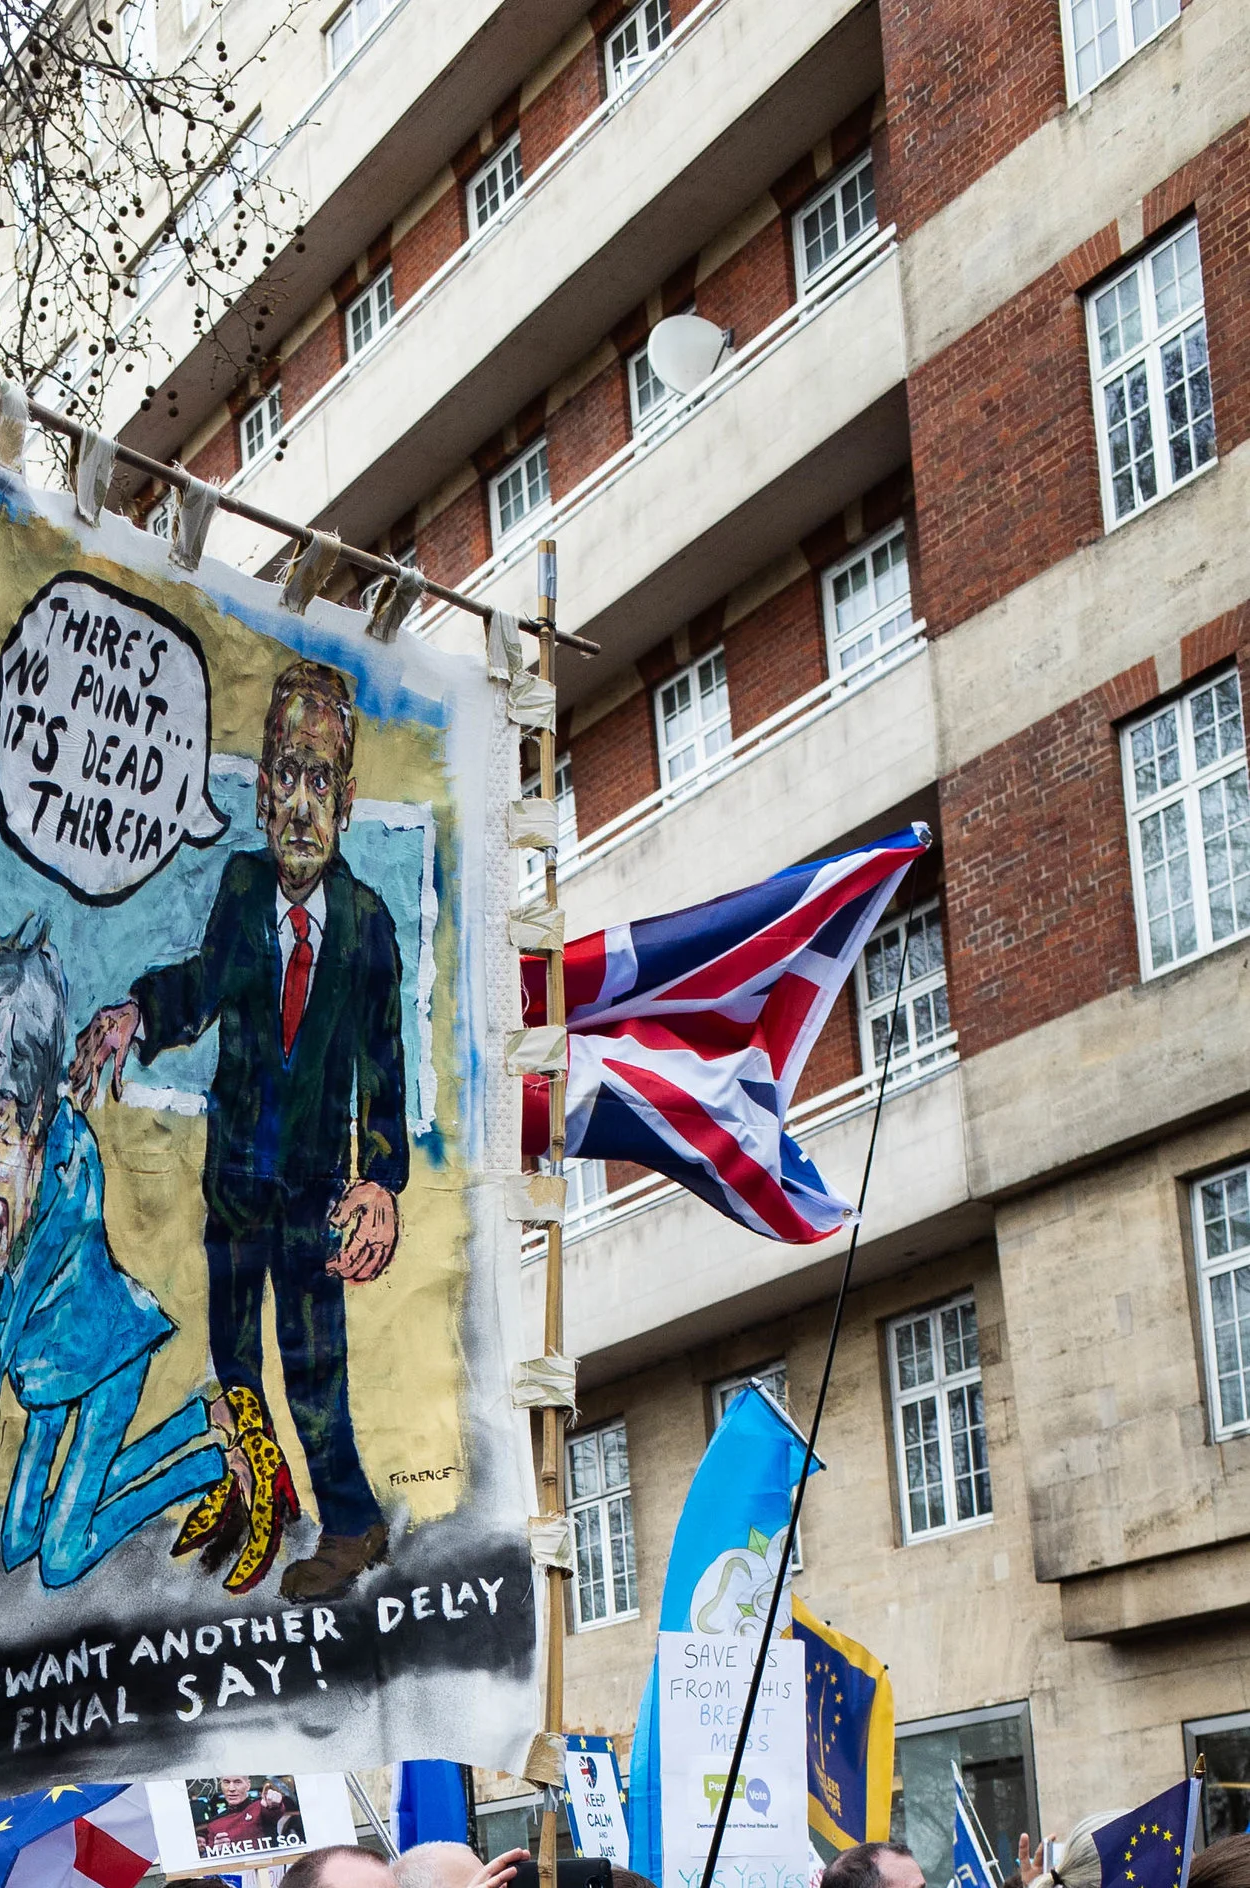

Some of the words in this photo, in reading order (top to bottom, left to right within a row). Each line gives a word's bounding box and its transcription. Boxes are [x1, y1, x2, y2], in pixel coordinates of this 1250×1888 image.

[46, 597, 168, 687] THERE'S
[5, 647, 49, 696] NO
[71, 664, 193, 750] POINT...
[3, 704, 68, 775] IT'S
[81, 729, 164, 795] DEAD
[5, 1638, 116, 1697] WANT
[129, 1606, 344, 1666] ANOTHER
[376, 1576, 504, 1634] DELAY
[684, 1644, 738, 1669] SAVE
[670, 1678, 730, 1700] FROM
[13, 1685, 139, 1751] FINAL
[700, 1703, 775, 1727] BREIT
[584, 1793, 606, 1807] KEEP
[749, 1790, 768, 1801] Vote
[587, 1813, 613, 1828] CALM
[205, 1839, 254, 1859] MAKE
[258, 1836, 272, 1851] IT
[276, 1833, 305, 1849] SO.
